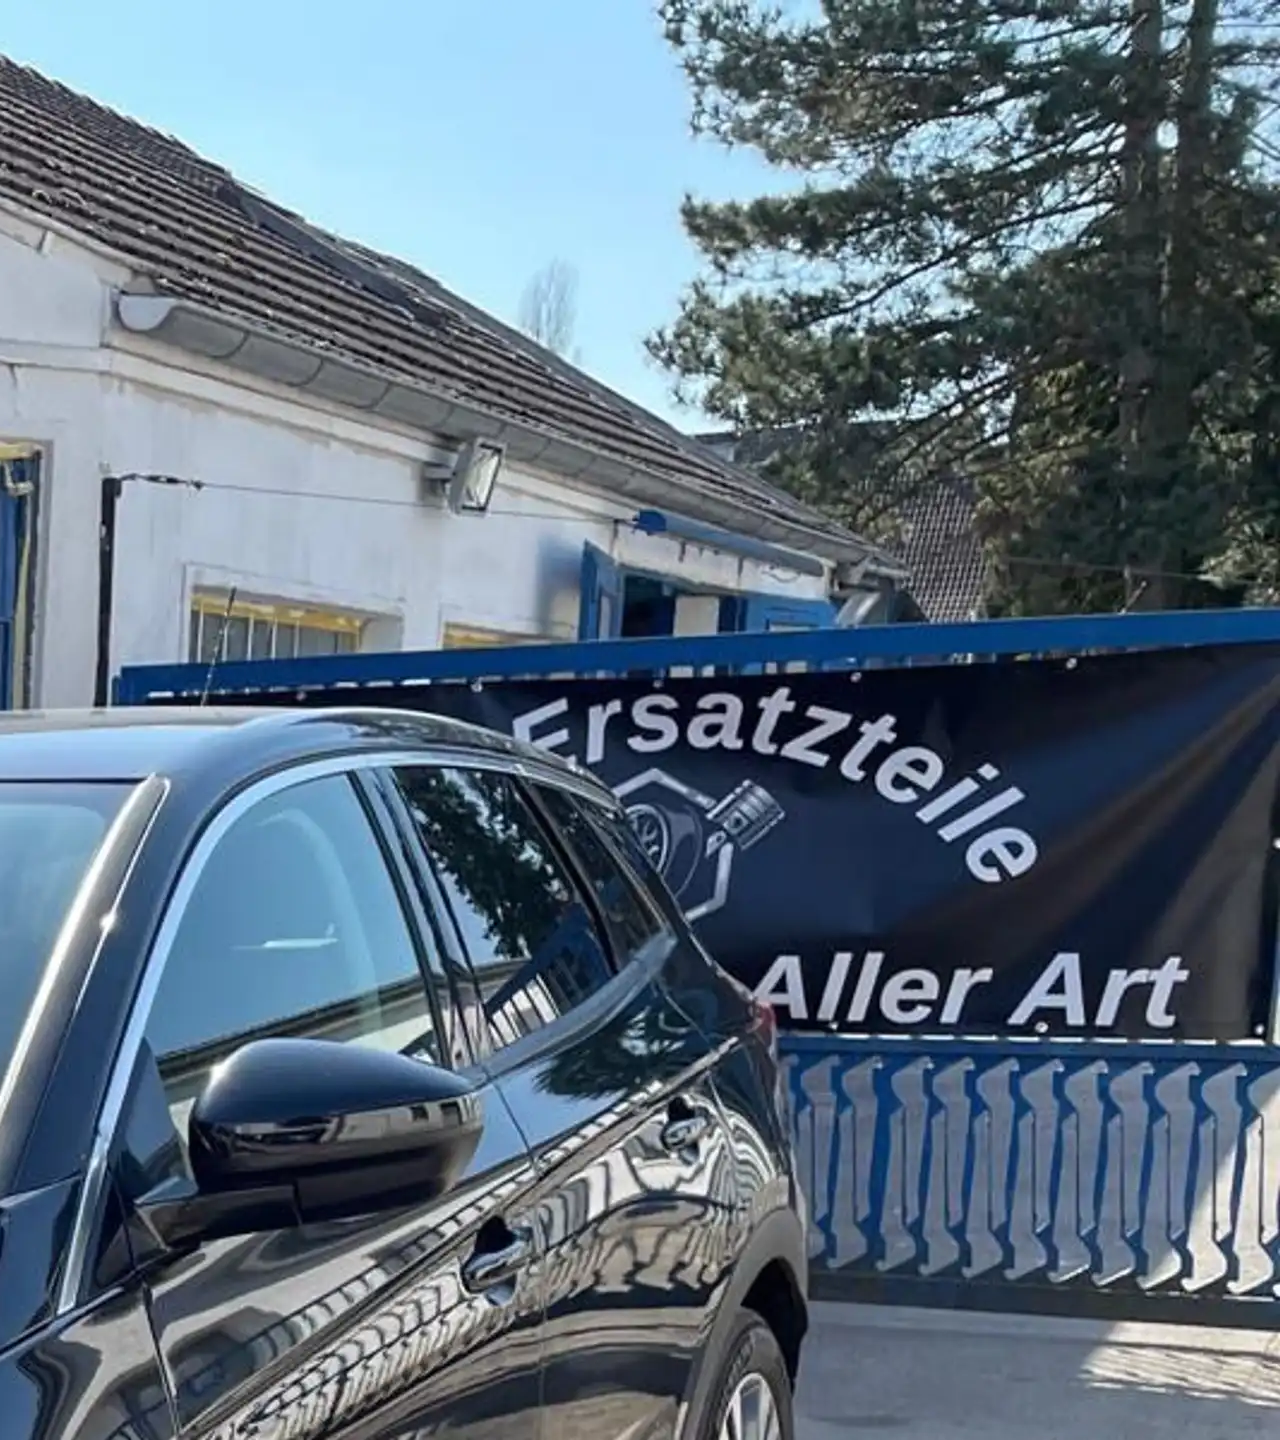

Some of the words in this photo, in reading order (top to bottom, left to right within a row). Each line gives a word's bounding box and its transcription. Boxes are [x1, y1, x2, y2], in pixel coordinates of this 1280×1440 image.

[511, 687, 1038, 884] Ersatzteile
[748, 952, 991, 1025] Aller
[1007, 952, 1189, 1026] Art
